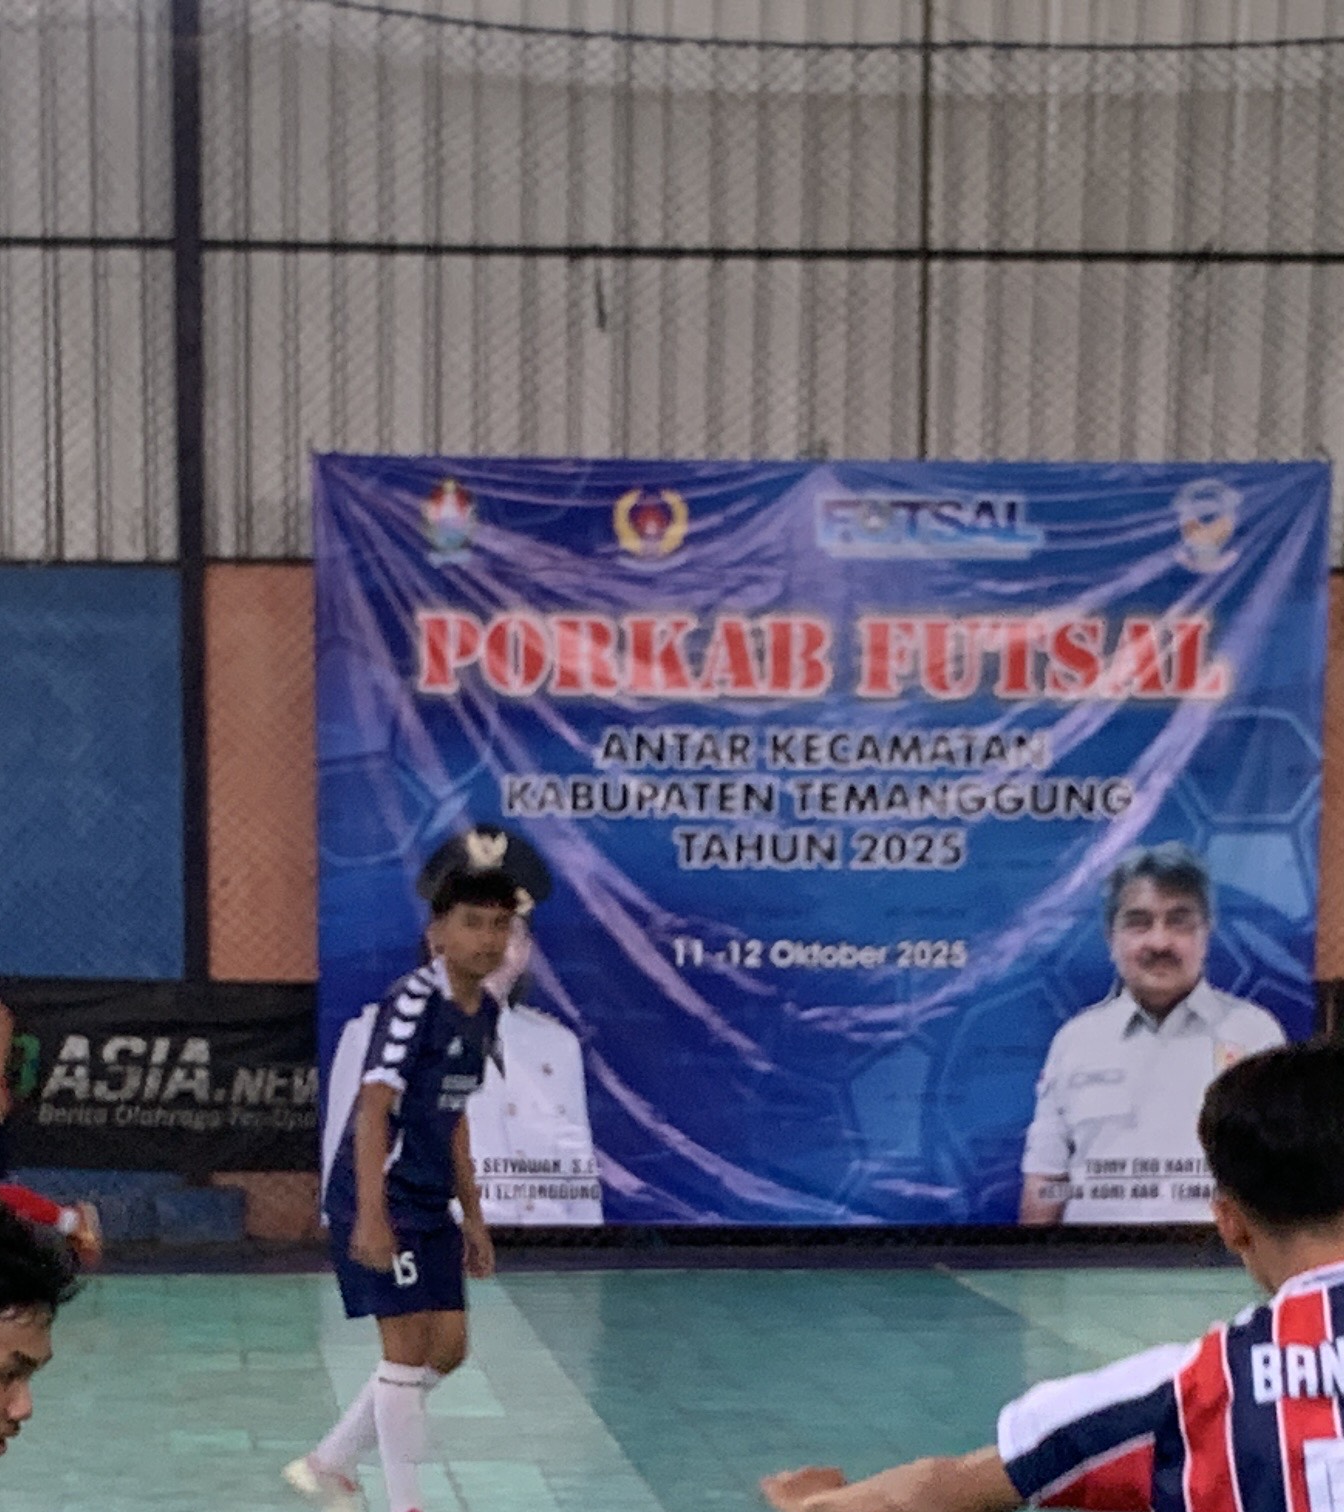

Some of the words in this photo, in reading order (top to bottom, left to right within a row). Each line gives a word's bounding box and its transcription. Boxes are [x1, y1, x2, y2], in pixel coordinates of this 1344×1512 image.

[420, 612, 832, 698] PORKAB
[858, 614, 1229, 702] FUTSAL
[603, 732, 751, 764] ANTAR
[771, 732, 1048, 768] KECAMATAN
[507, 780, 775, 814] KABUPATEN
[794, 780, 1133, 815] TEMANGGUNG
[677, 832, 837, 864] TAHUN
[856, 832, 961, 866] 2025
[770, 939, 886, 969] Oktober
[898, 939, 968, 969] 2025
